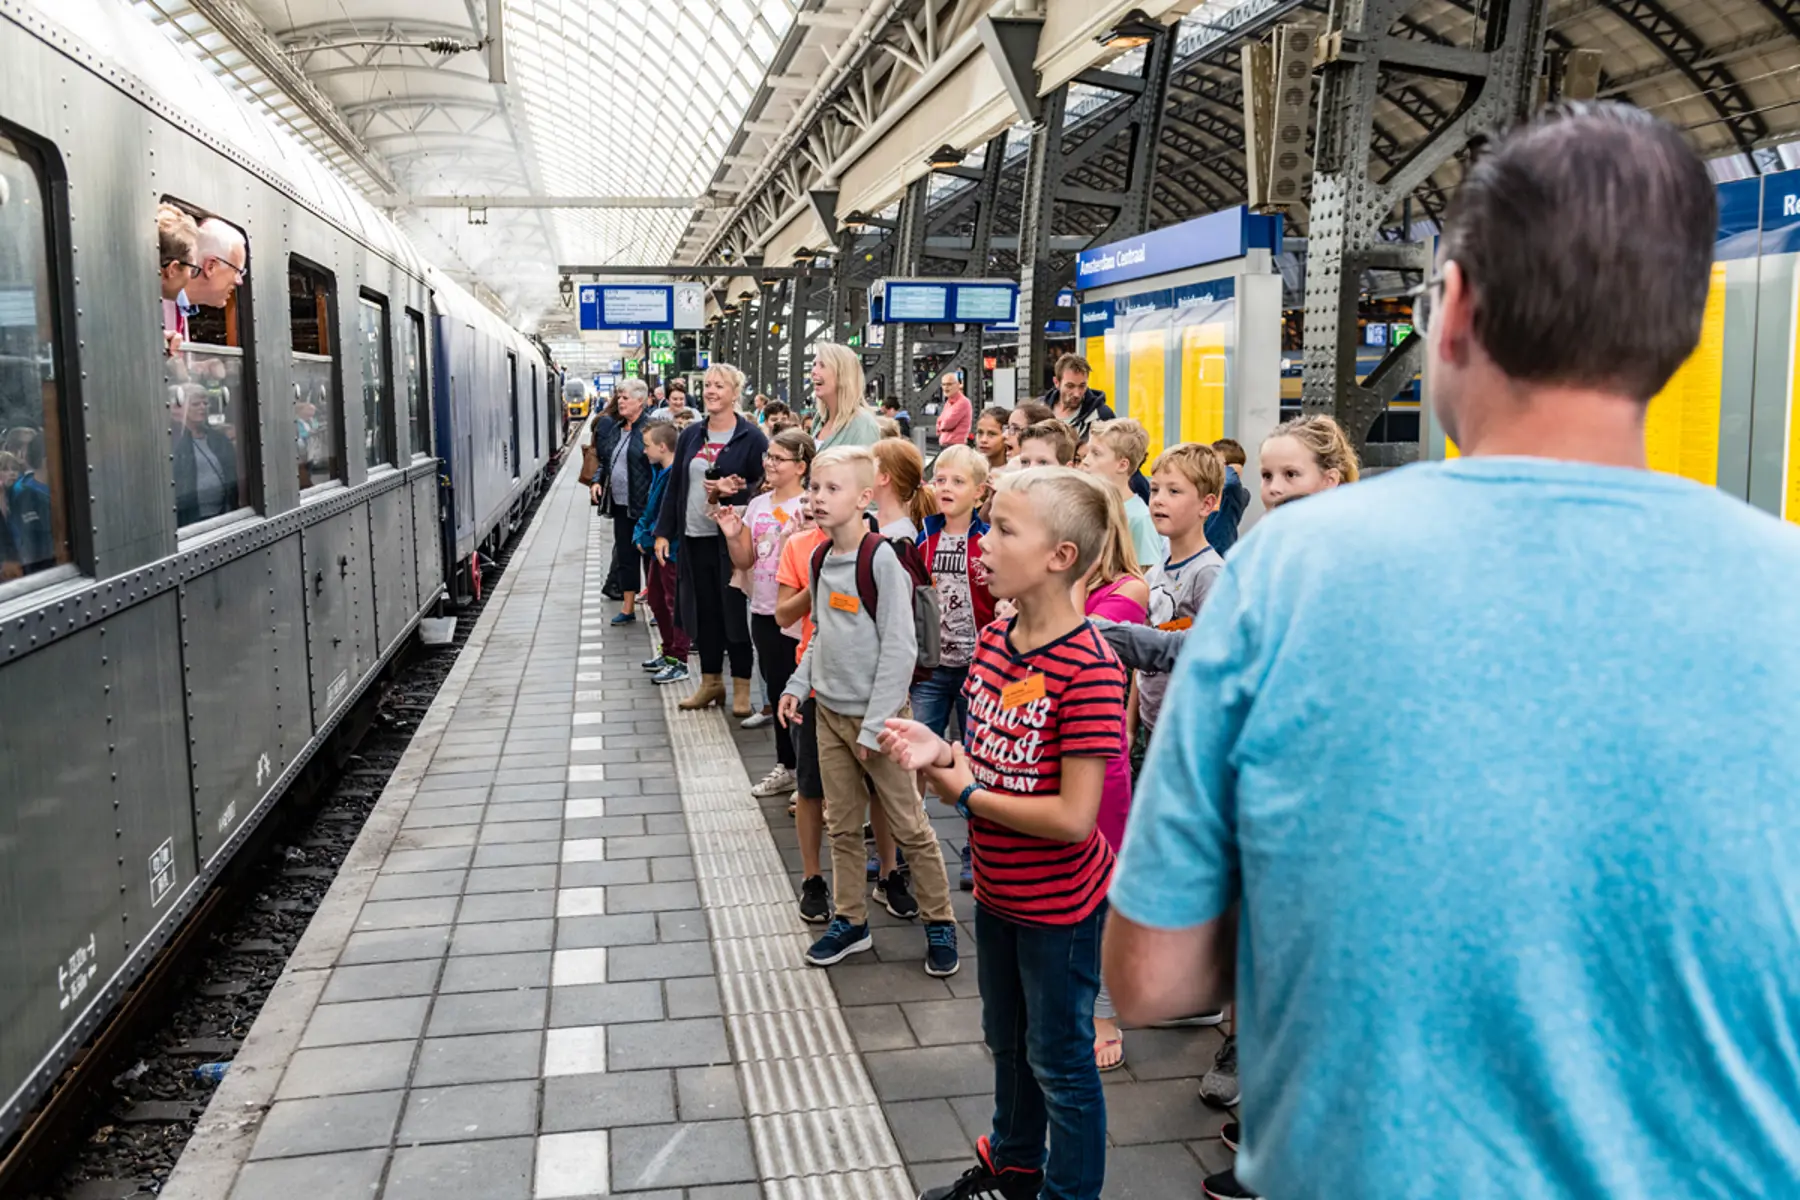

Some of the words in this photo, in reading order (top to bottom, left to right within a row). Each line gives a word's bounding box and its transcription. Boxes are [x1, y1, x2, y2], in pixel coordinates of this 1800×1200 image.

[1080, 253, 1115, 276] Amsterdam
[1116, 243, 1146, 267] Centraal
[1022, 697, 1051, 728] 93
[971, 723, 1044, 764] Coast
[1003, 776, 1039, 792] BAY
